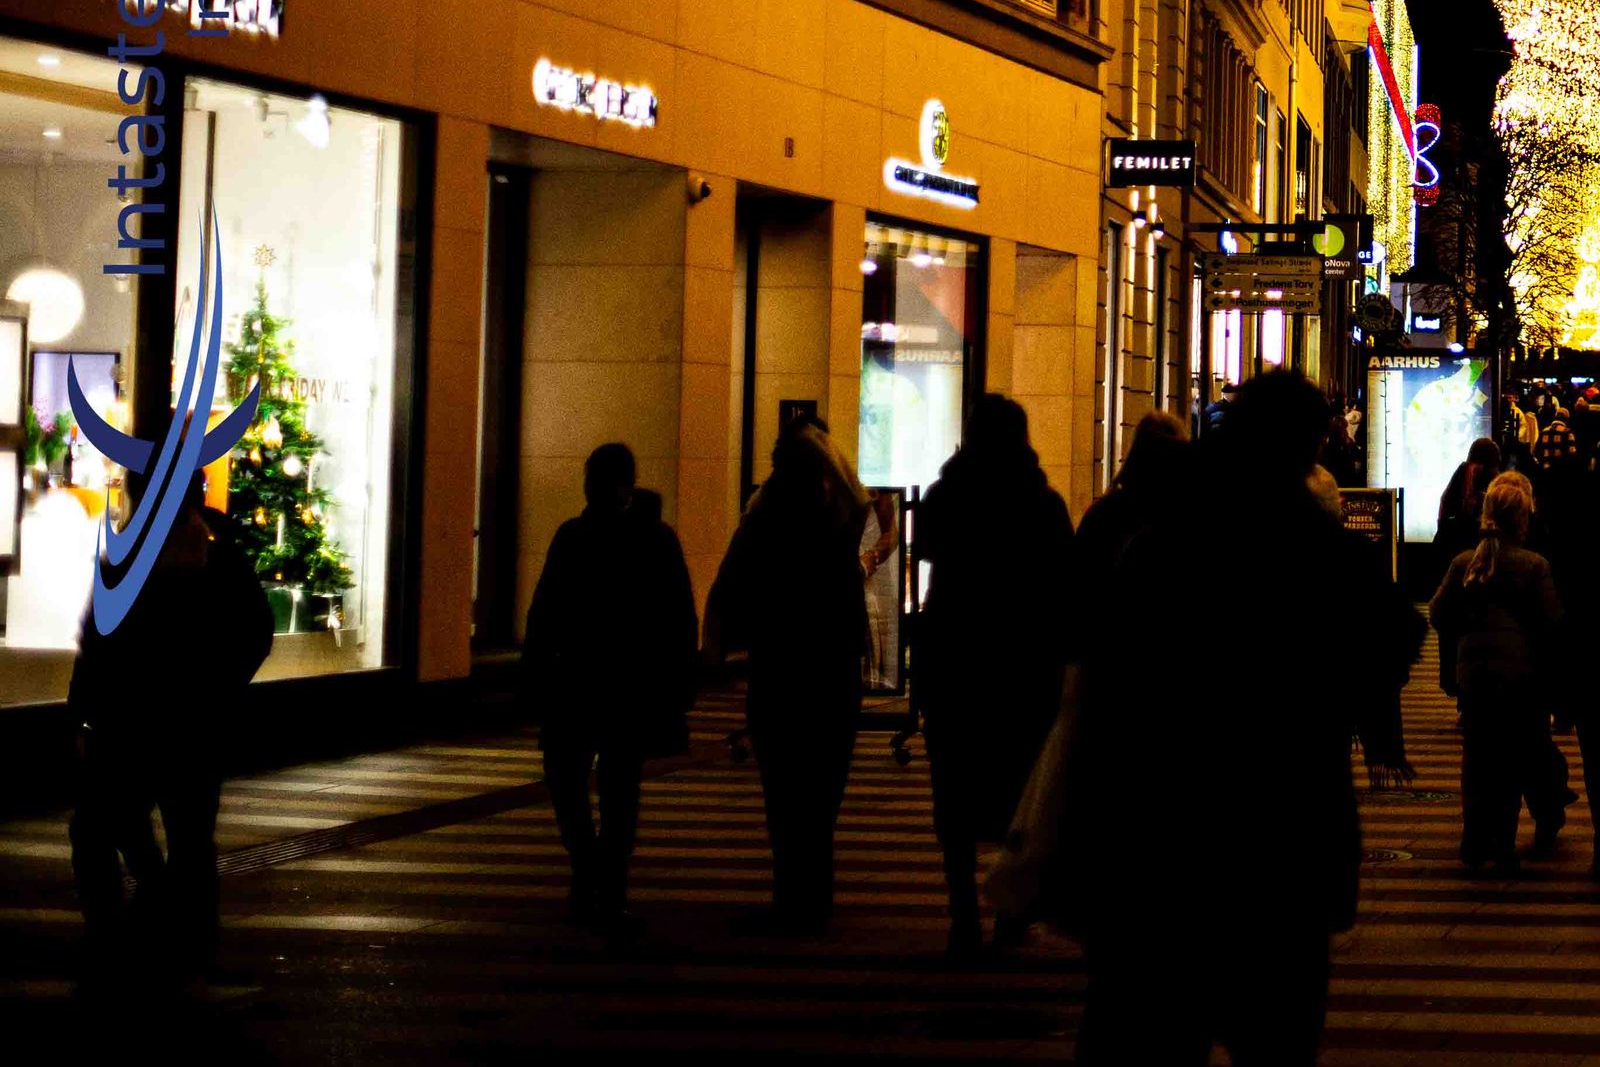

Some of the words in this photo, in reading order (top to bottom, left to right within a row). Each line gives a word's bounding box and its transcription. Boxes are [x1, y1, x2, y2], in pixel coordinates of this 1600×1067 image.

[1113, 156, 1191, 169] FEMILET
[1254, 279, 1292, 288] Fredens
[1294, 279, 1314, 289] Torv
[1368, 356, 1440, 368] AARHUS
